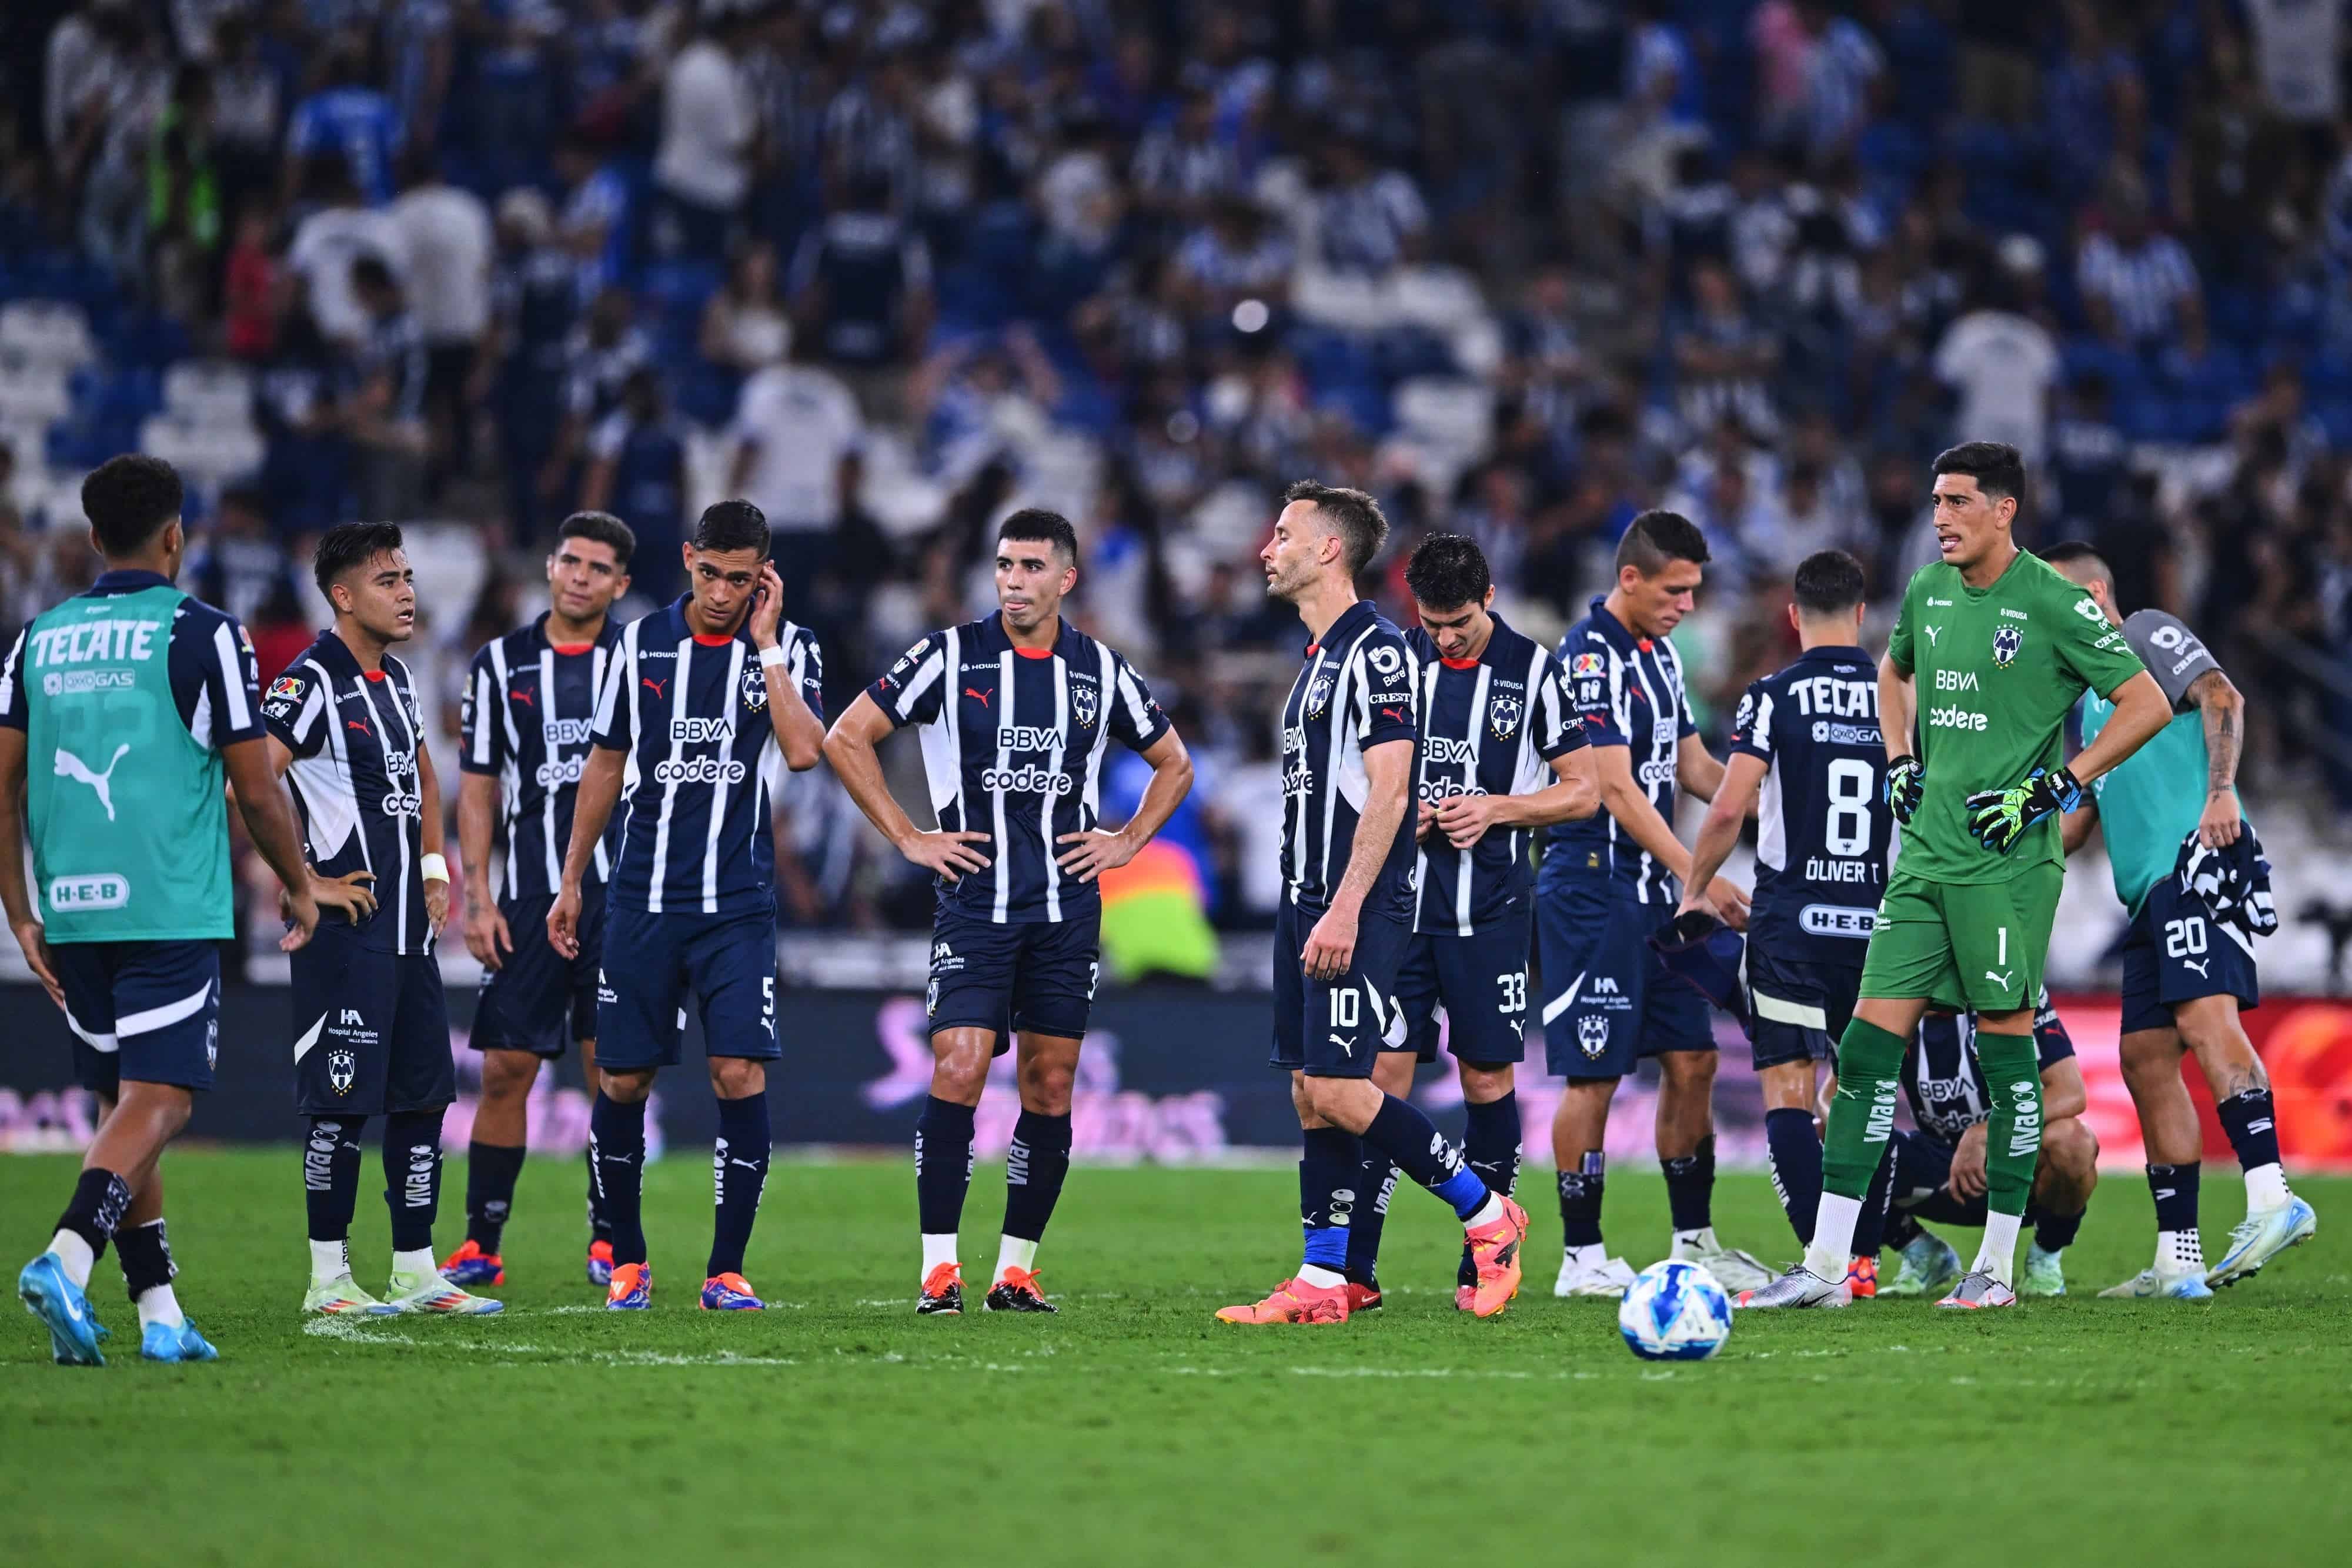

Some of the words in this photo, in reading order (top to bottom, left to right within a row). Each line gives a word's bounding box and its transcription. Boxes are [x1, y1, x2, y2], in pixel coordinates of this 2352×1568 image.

[2006, 609, 2027, 620] VIDUSA
[30, 619, 161, 668] TECATE
[1499, 679, 1524, 690] VIDUSA
[1936, 669, 1979, 692] BBVA
[1369, 693, 1411, 704] CREST
[1788, 677, 1879, 718] TECAT
[1929, 703, 1988, 731] codere
[547, 724, 589, 743] BBV
[673, 720, 733, 739] BBVA
[1000, 728, 1064, 749] BBVA
[656, 757, 743, 780] codere
[983, 767, 1070, 793] codere
[1826, 758, 1875, 857] 8
[1805, 855, 1866, 882] ÓLIVER
[1998, 927, 2007, 965] 1
[2165, 916, 2208, 958] 20
[763, 977, 774, 1015] 5
[1497, 972, 1526, 1013] 33
[340, 1009, 364, 1026] HA
[1330, 988, 1359, 1027] 10
[328, 1027, 351, 1037] Hospital
[352, 1029, 378, 1039] Angeles
[1919, 1078, 1974, 1099] BBVA
